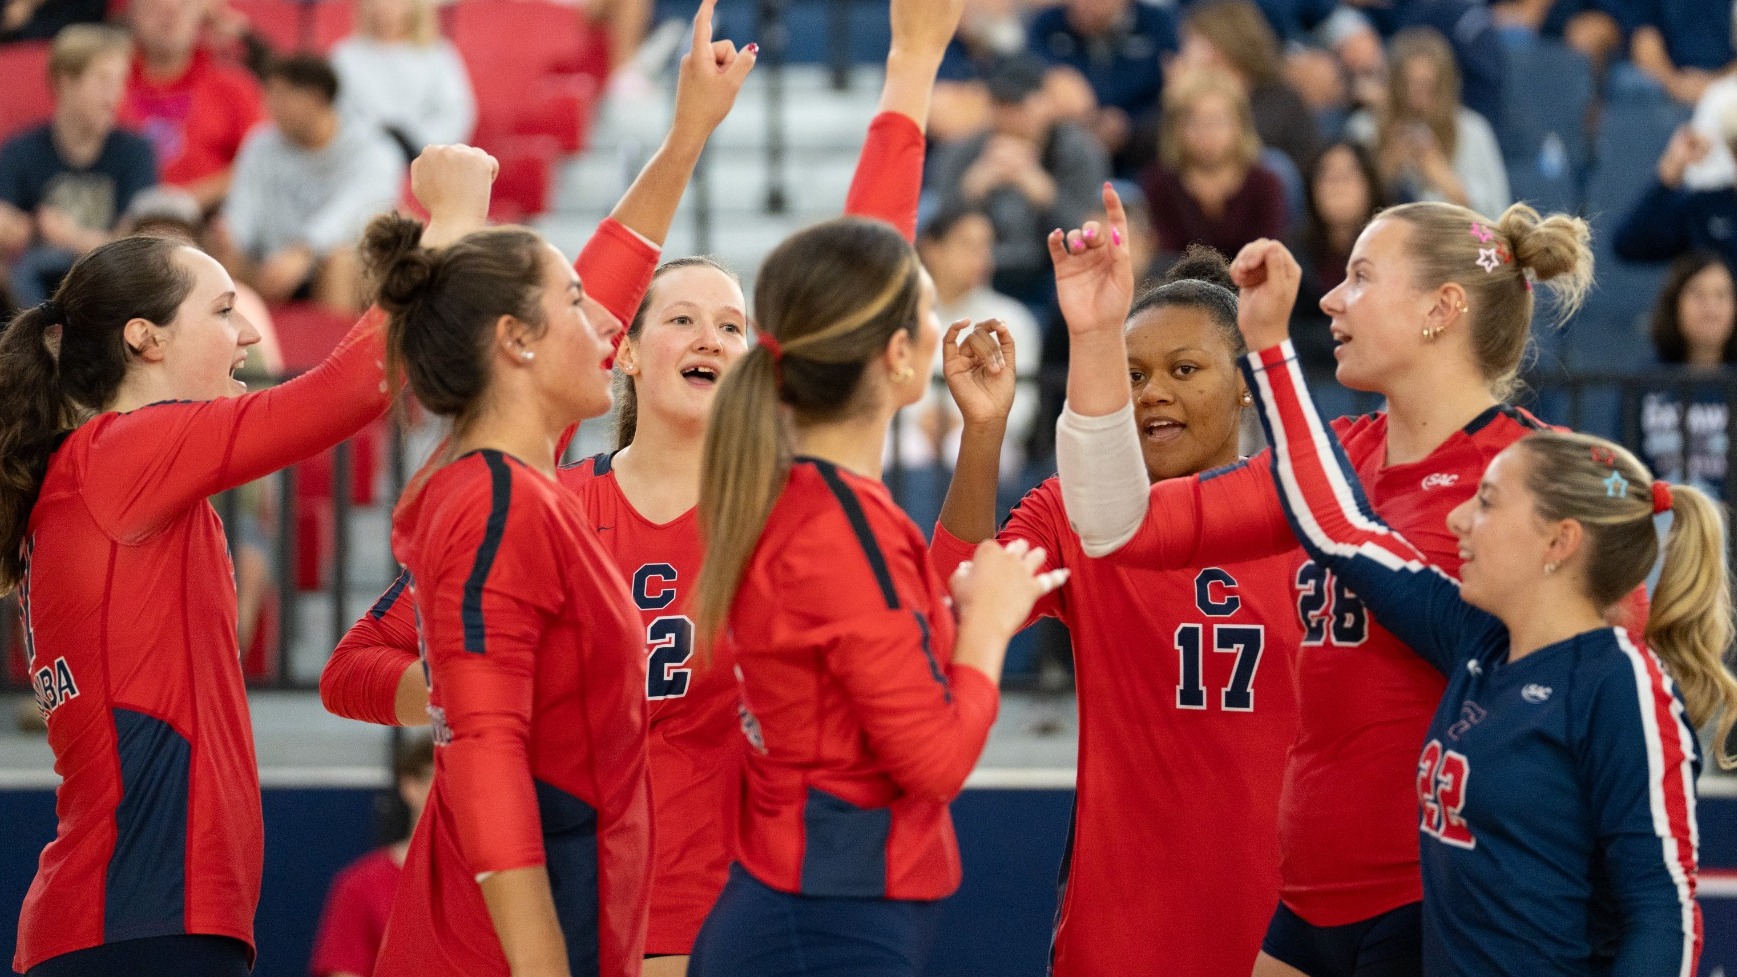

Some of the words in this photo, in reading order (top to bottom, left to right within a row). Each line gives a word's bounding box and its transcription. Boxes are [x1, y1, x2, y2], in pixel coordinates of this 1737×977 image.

[632, 562, 678, 611] C
[1194, 566, 1241, 617] C
[1295, 559, 1369, 648] 26
[33, 655, 80, 721] BA
[1173, 622, 1265, 713] 17
[1416, 738, 1477, 851] 22
